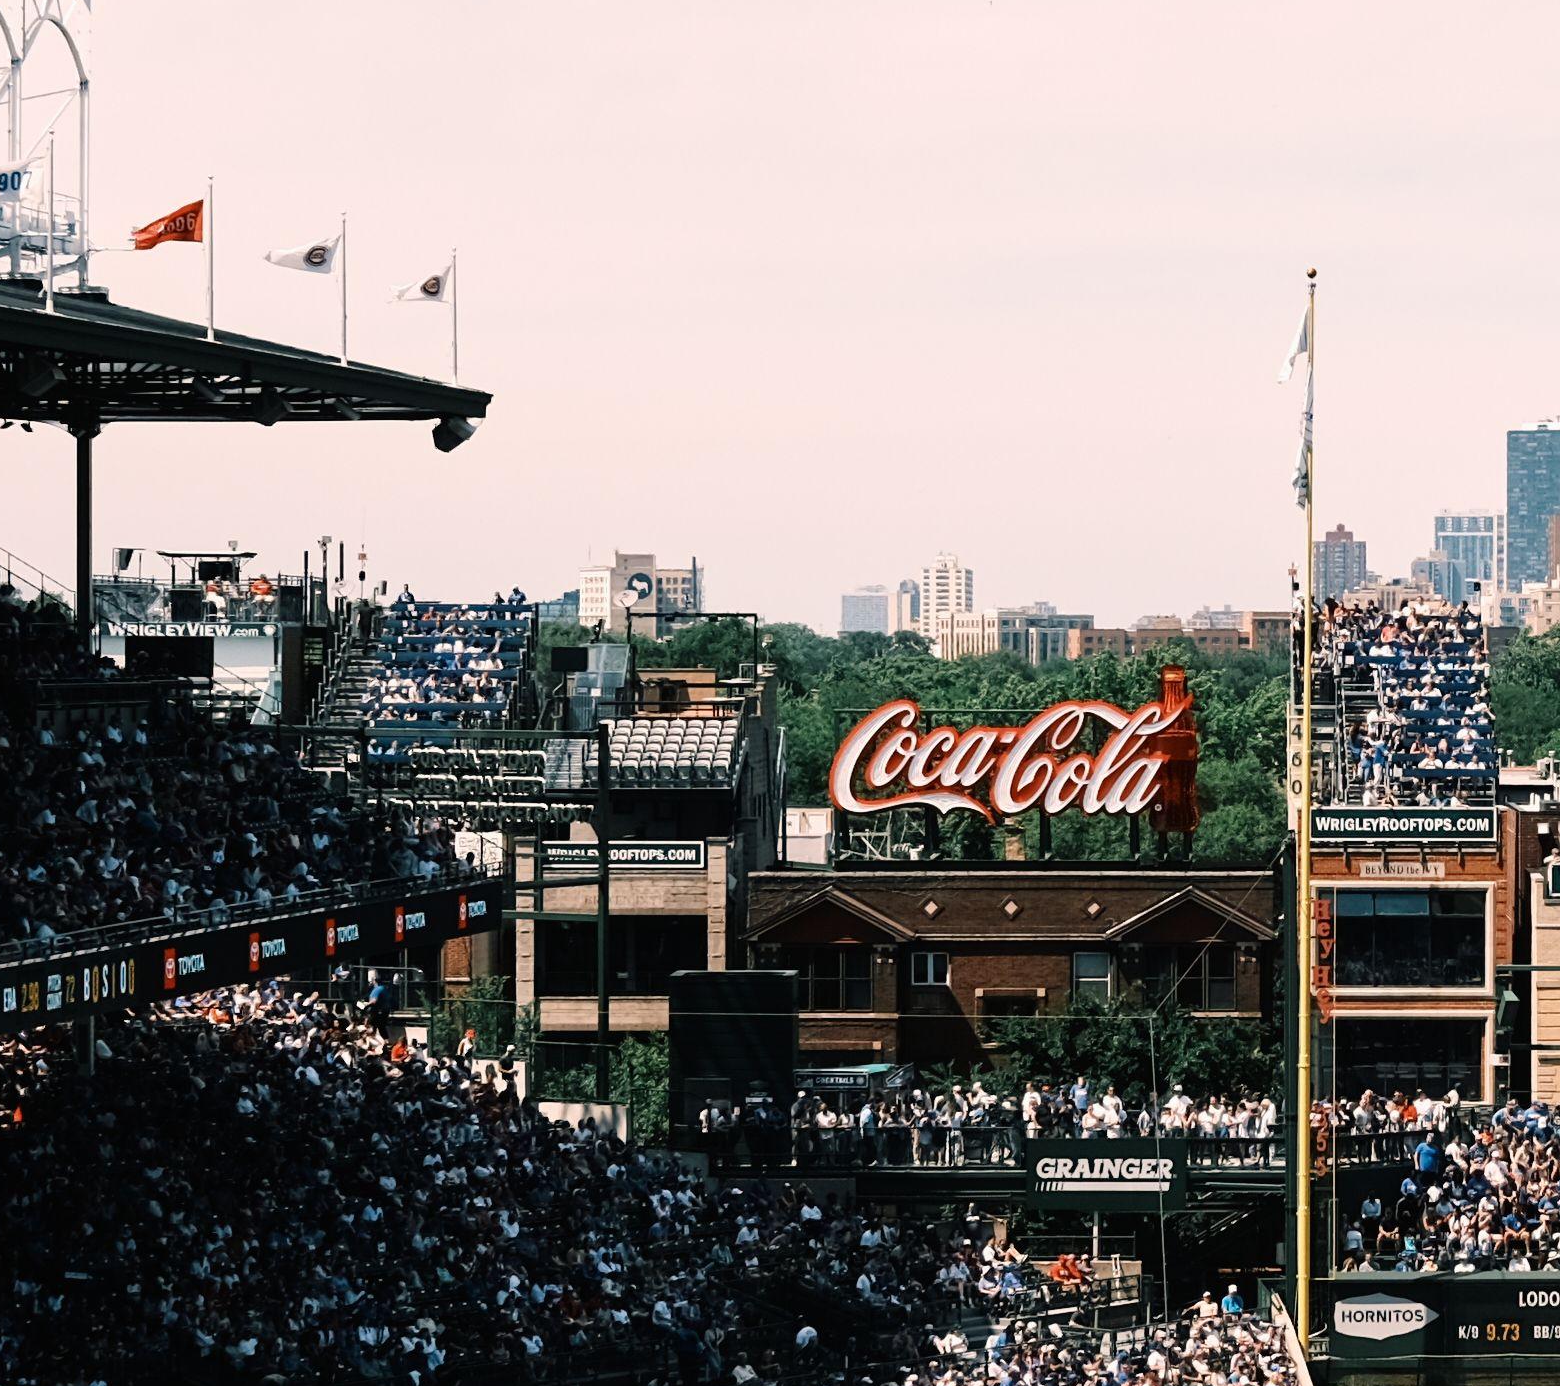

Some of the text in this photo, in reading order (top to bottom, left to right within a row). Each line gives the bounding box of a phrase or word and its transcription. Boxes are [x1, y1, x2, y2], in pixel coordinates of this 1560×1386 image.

[107, 621, 259, 637] WRIGLEYVIEW.com
[834, 701, 1185, 816] Coca-Cola
[1291, 723, 1303, 795] 460
[337, 924, 360, 944] TOYOTA
[261, 938, 286, 959] TOYOTA
[178, 953, 205, 976] TOYOTA
[83, 968, 91, 1002] B
[102, 964, 109, 998] S
[1035, 1157, 1174, 1179] GRAINGER
[1341, 1309, 1424, 1324] HORNITOS
[1458, 1324, 1479, 1340] K/9
[1486, 1323, 1520, 1341] 9.73
